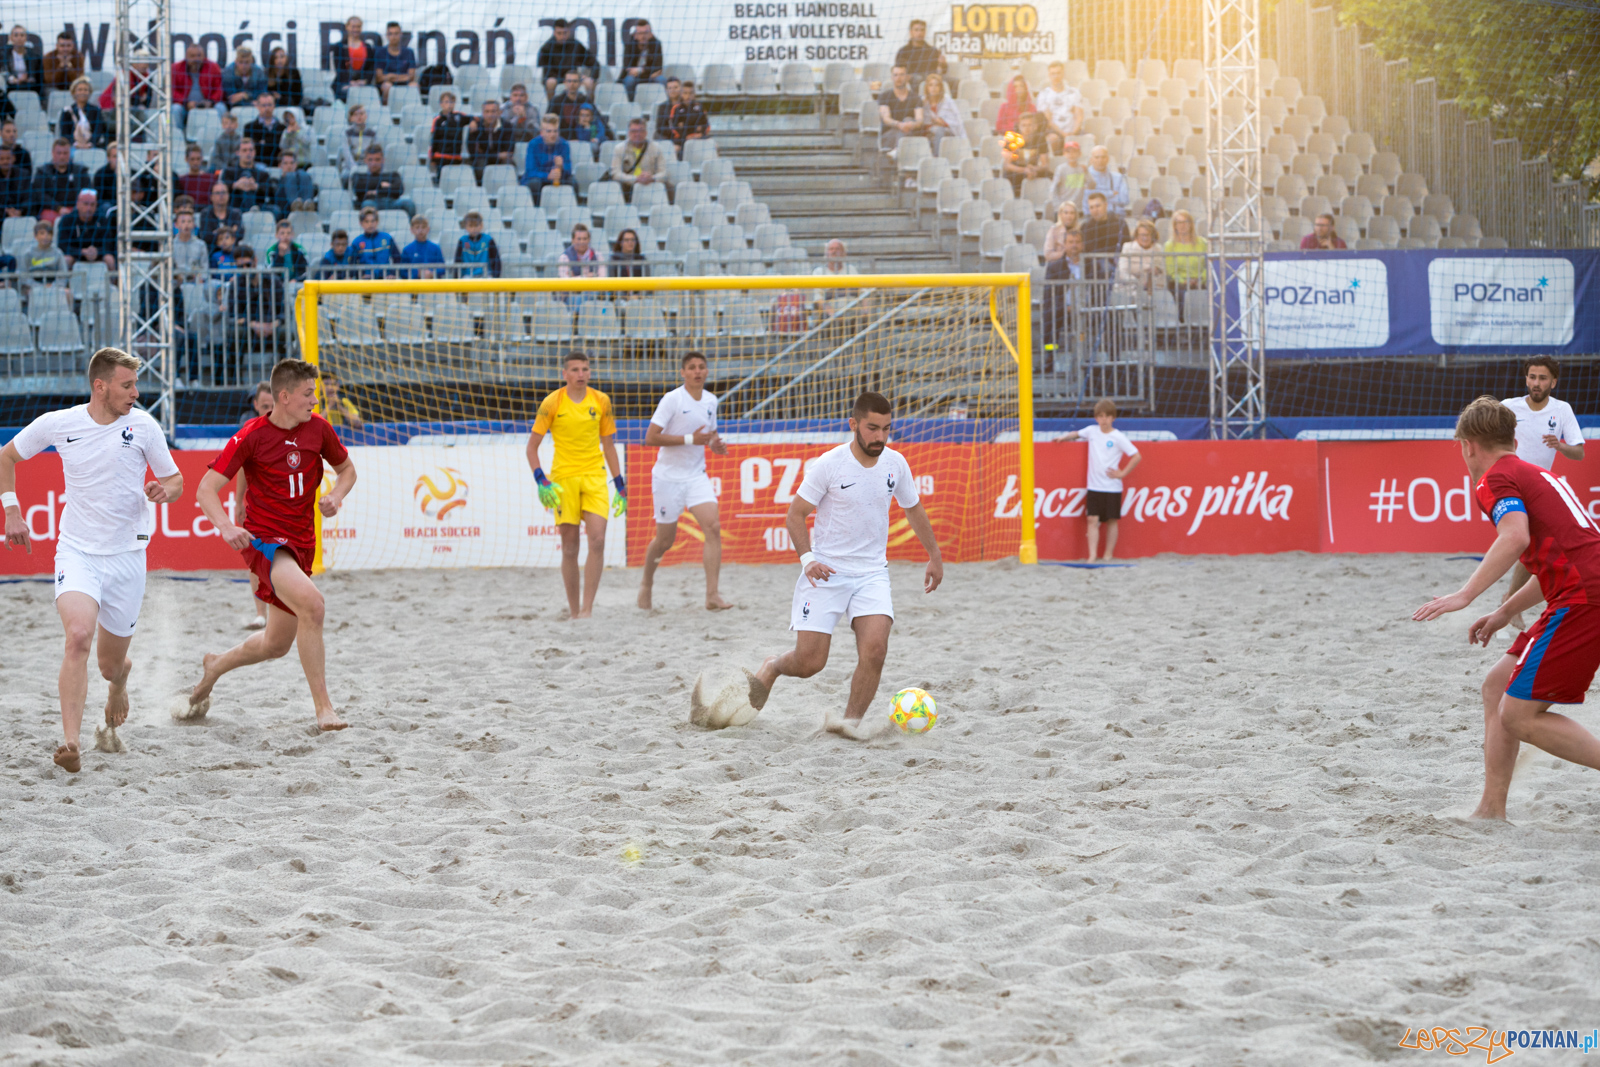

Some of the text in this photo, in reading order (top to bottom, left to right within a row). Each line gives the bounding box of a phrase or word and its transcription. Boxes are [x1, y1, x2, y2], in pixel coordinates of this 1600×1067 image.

[734, 3, 877, 18] BEACH HANDBALL
[951, 4, 1038, 34] LOTTO
[729, 23, 884, 40] BEACH VOLLEYBALL
[745, 45, 869, 61] BEACH SOCCER
[288, 472, 304, 498] 11
[1186, 470, 1294, 537] piłka
[403, 526, 481, 538] BEACH SOCCER
